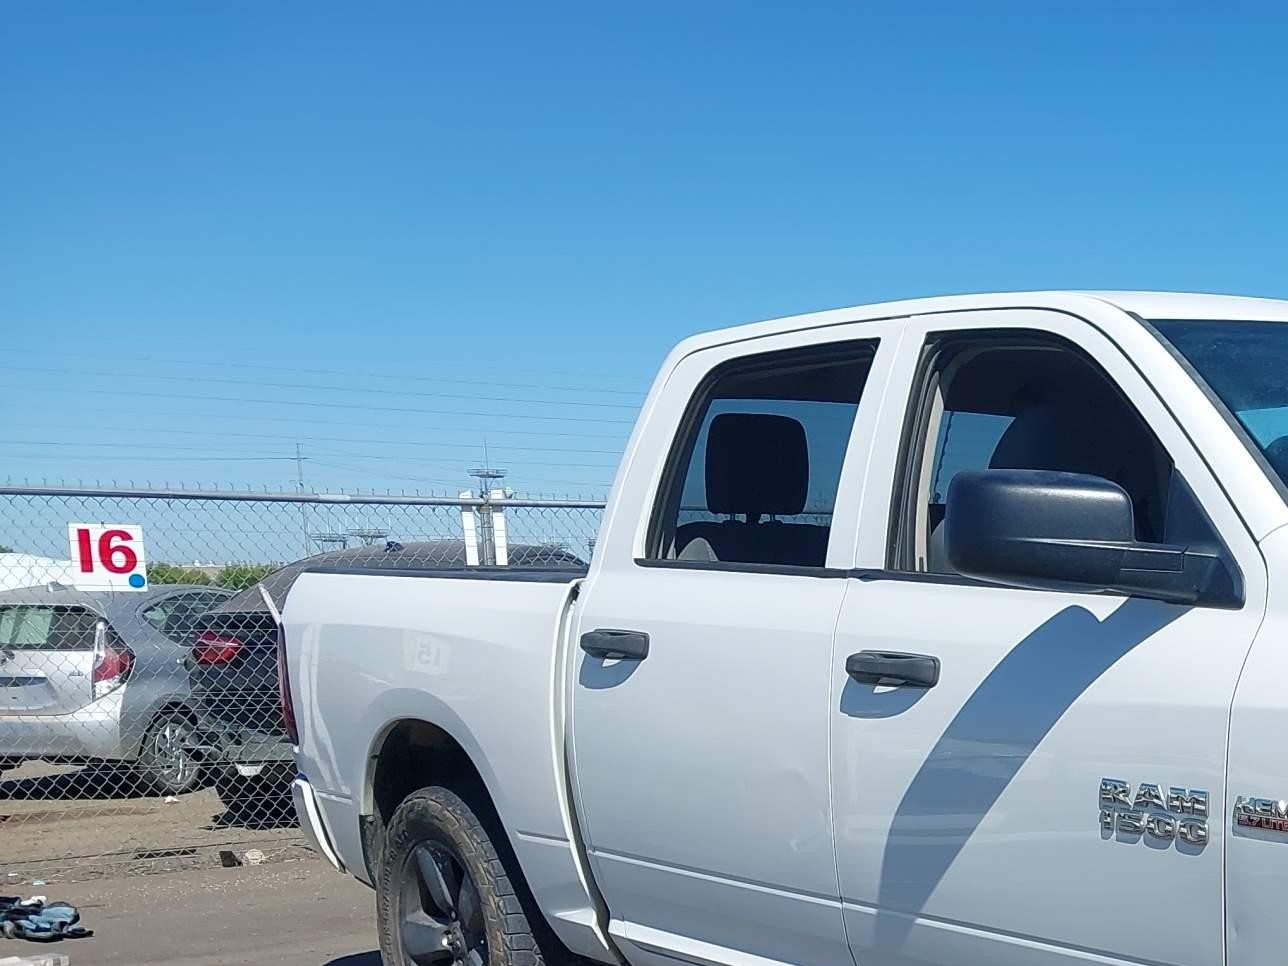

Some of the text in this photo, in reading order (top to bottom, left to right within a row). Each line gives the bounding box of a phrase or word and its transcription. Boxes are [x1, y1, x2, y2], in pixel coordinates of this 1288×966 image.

[77, 528, 138, 574] 16
[1099, 777, 1210, 819] RAM
[1099, 808, 1210, 850] 1500
